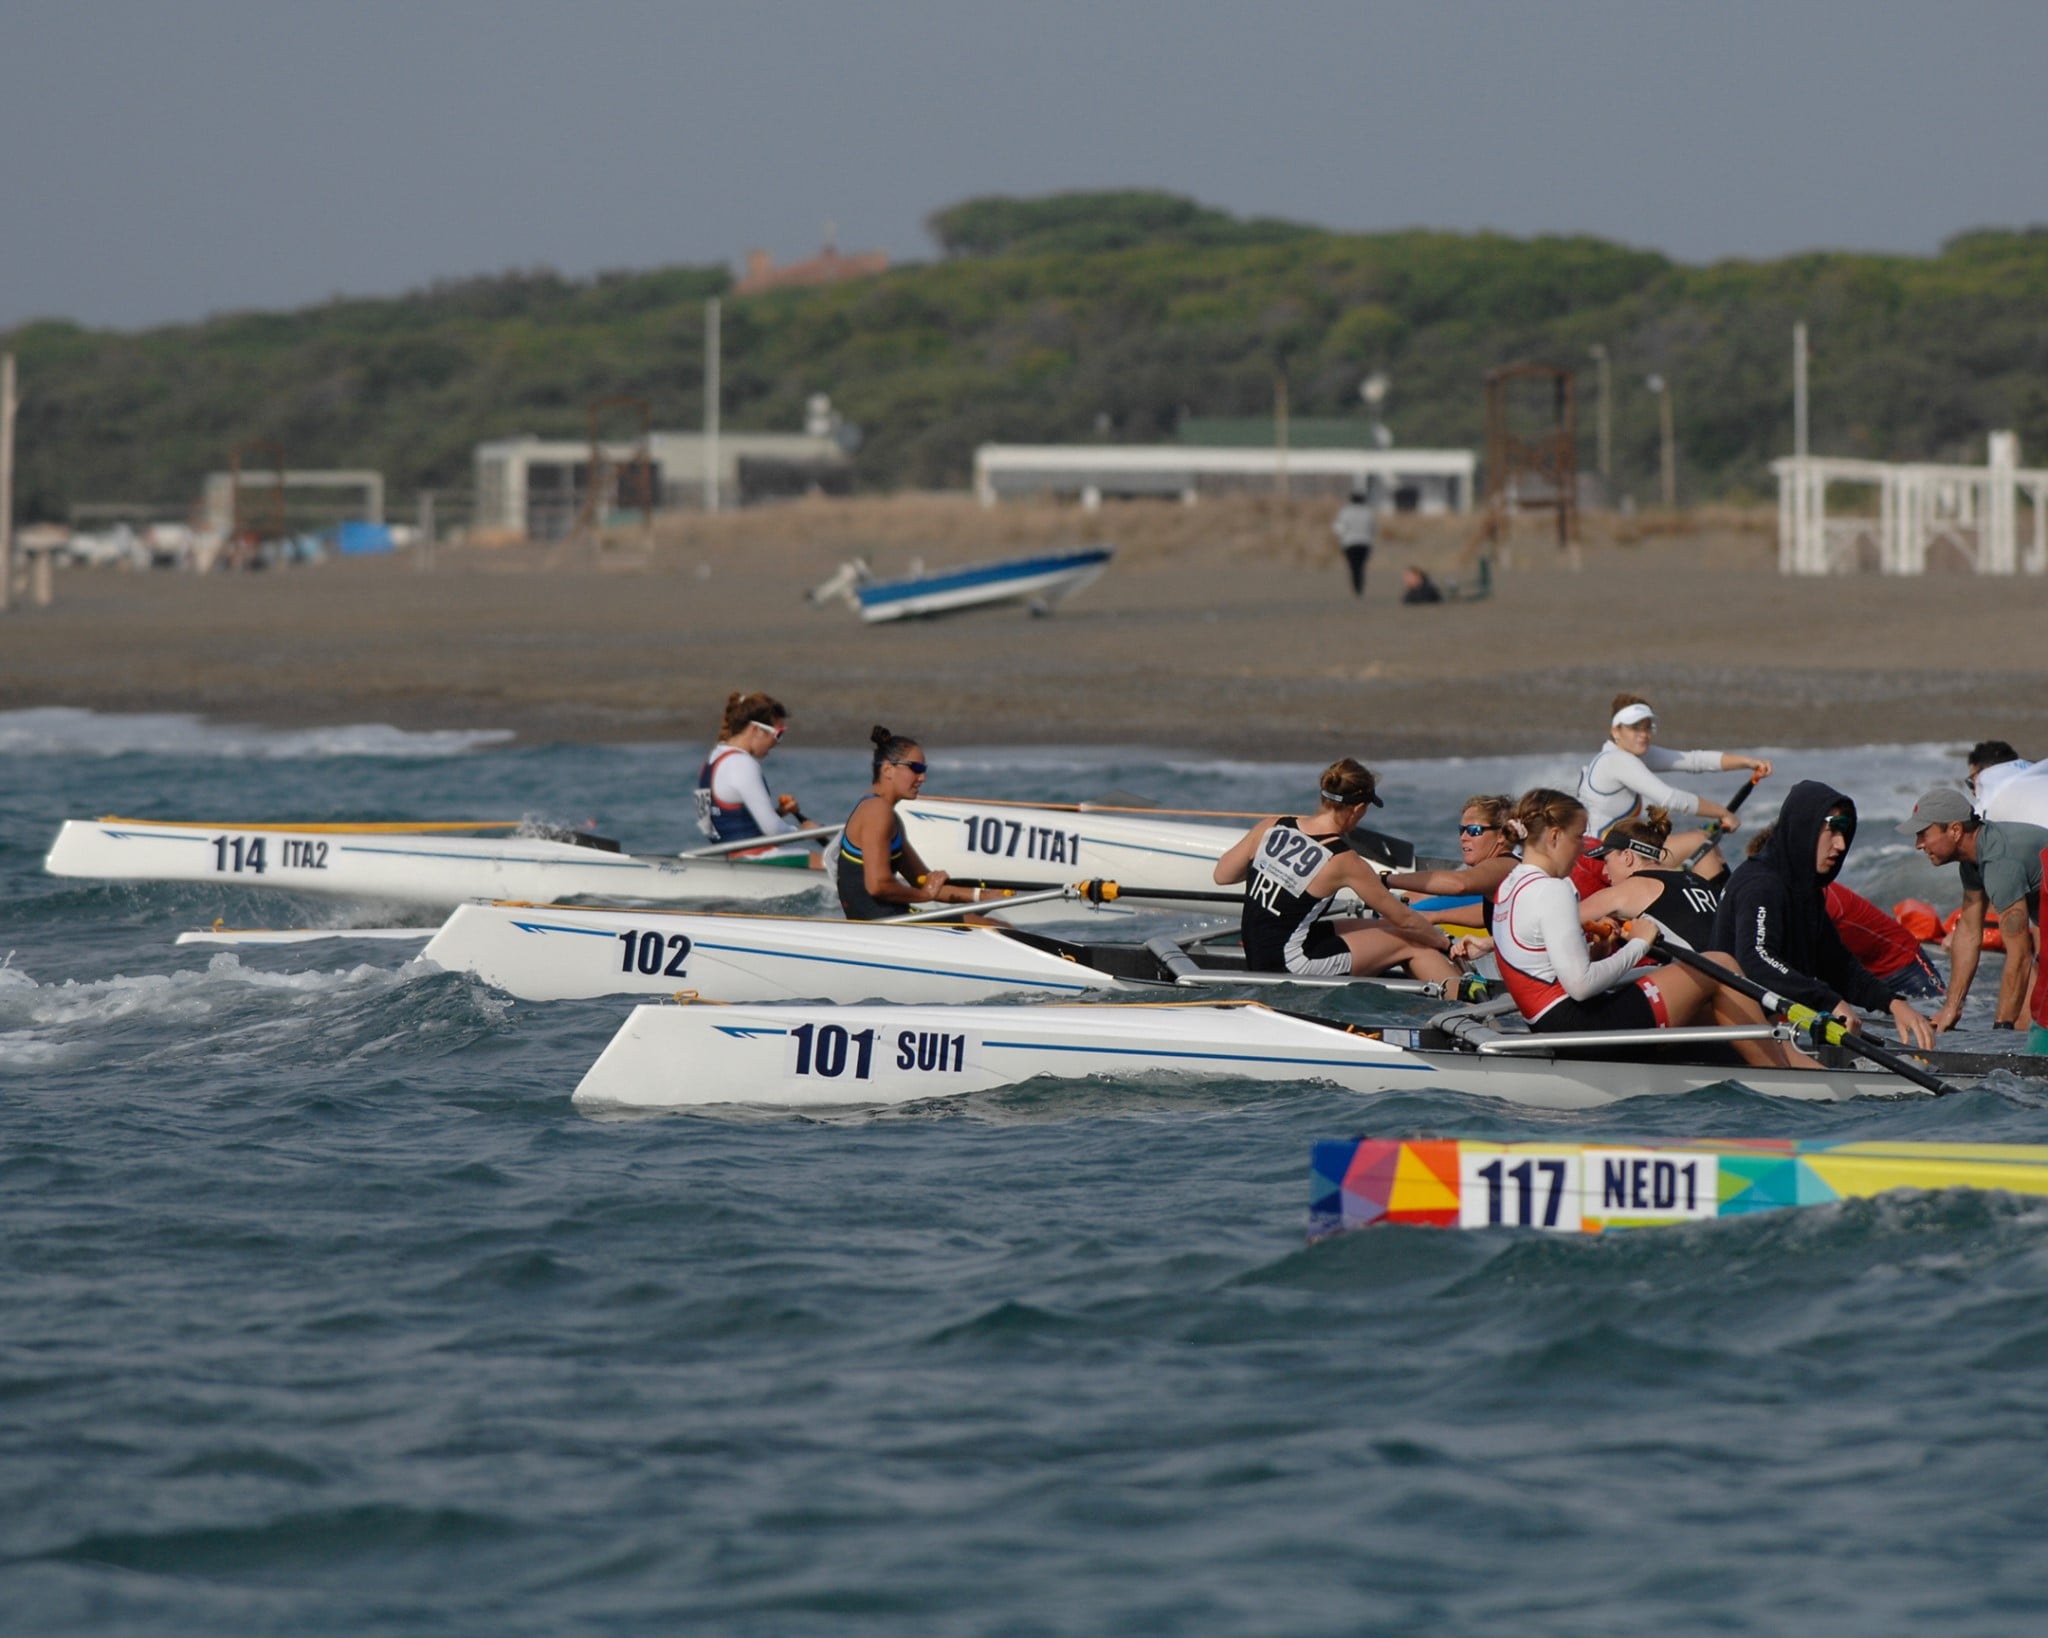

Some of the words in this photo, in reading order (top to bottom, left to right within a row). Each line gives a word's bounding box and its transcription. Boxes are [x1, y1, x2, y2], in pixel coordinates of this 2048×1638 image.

[212, 835, 268, 874] 114
[282, 840, 329, 869] ITA2
[963, 815, 1022, 857] 107
[1027, 826, 1079, 866] ITA1
[1265, 829, 1323, 877] 029
[1249, 871, 1281, 917] IRL
[619, 930, 691, 978] 102
[791, 1023, 875, 1079] 101
[896, 1030, 965, 1072] SUI1
[1478, 1159, 1566, 1227] 117
[1603, 1159, 1695, 1210] NED1
